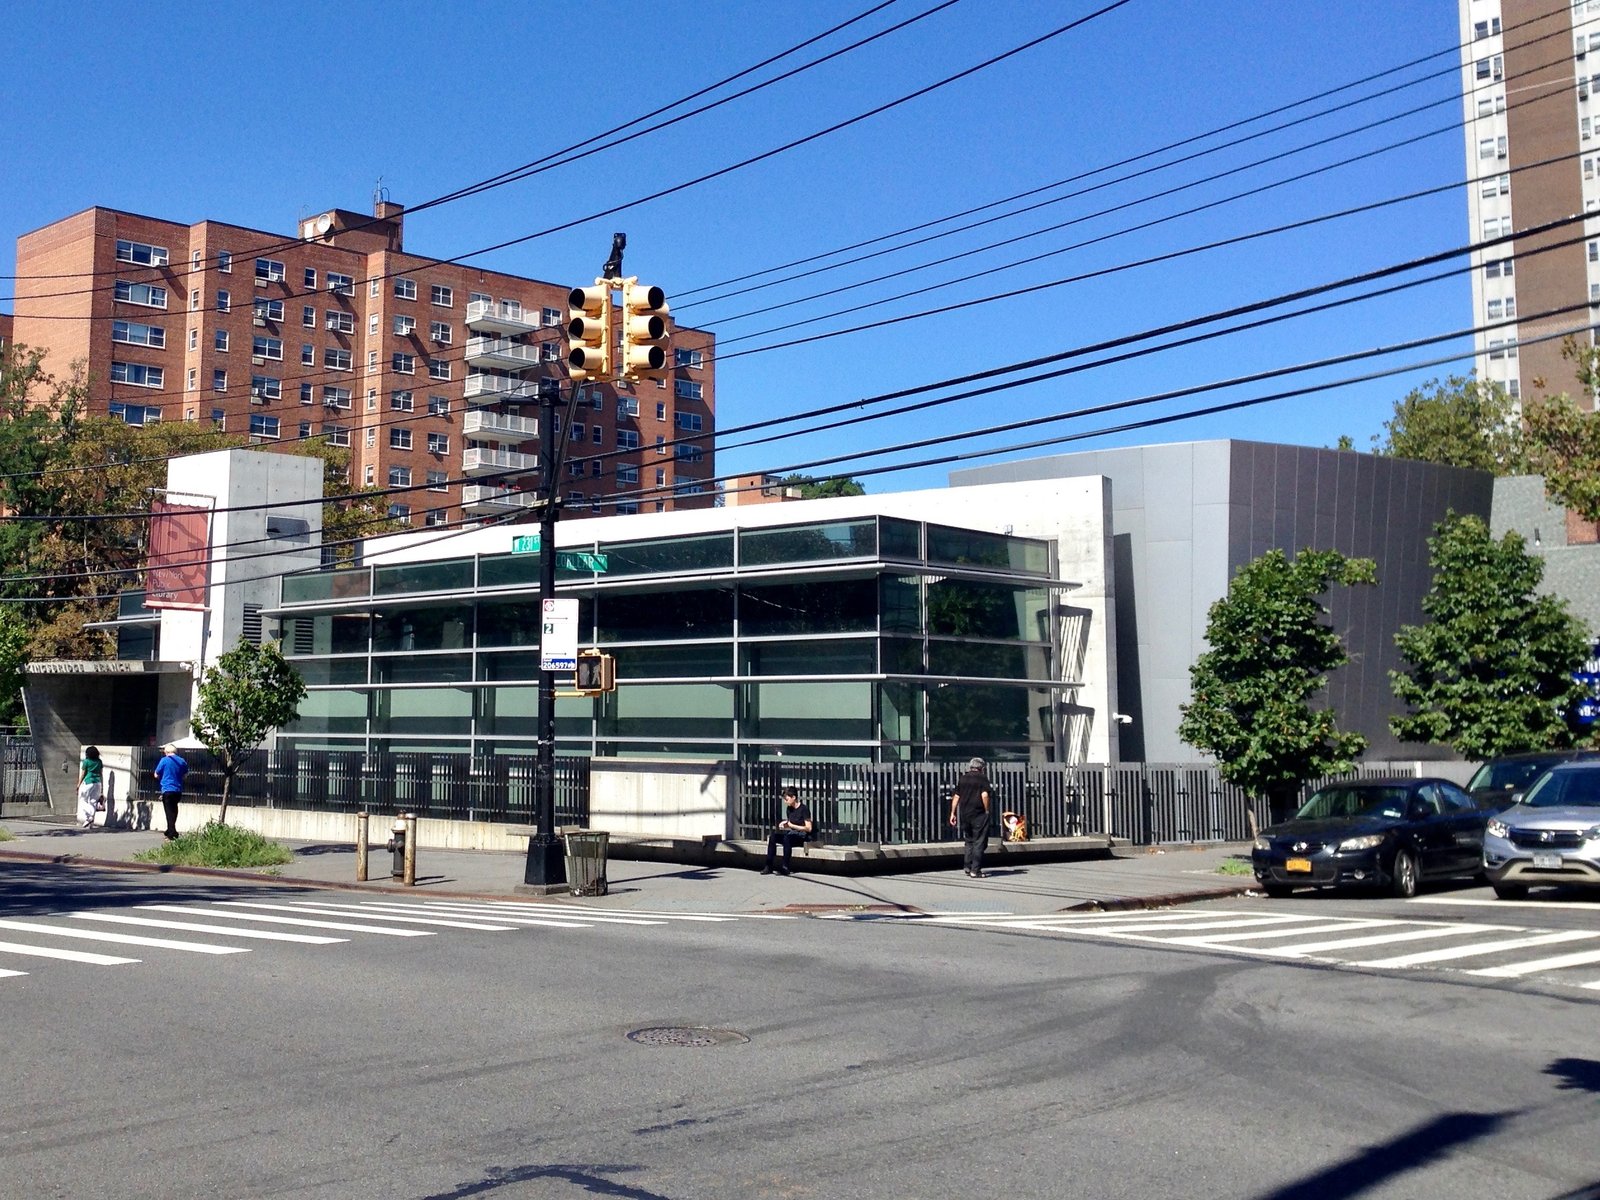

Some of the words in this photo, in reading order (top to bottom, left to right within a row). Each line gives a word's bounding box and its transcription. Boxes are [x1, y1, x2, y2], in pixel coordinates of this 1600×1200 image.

[555, 554, 595, 569] CORLEAR
[169, 570, 185, 580] York
[152, 578, 171, 588] Pubc
[94, 661, 131, 672] BRANCH
